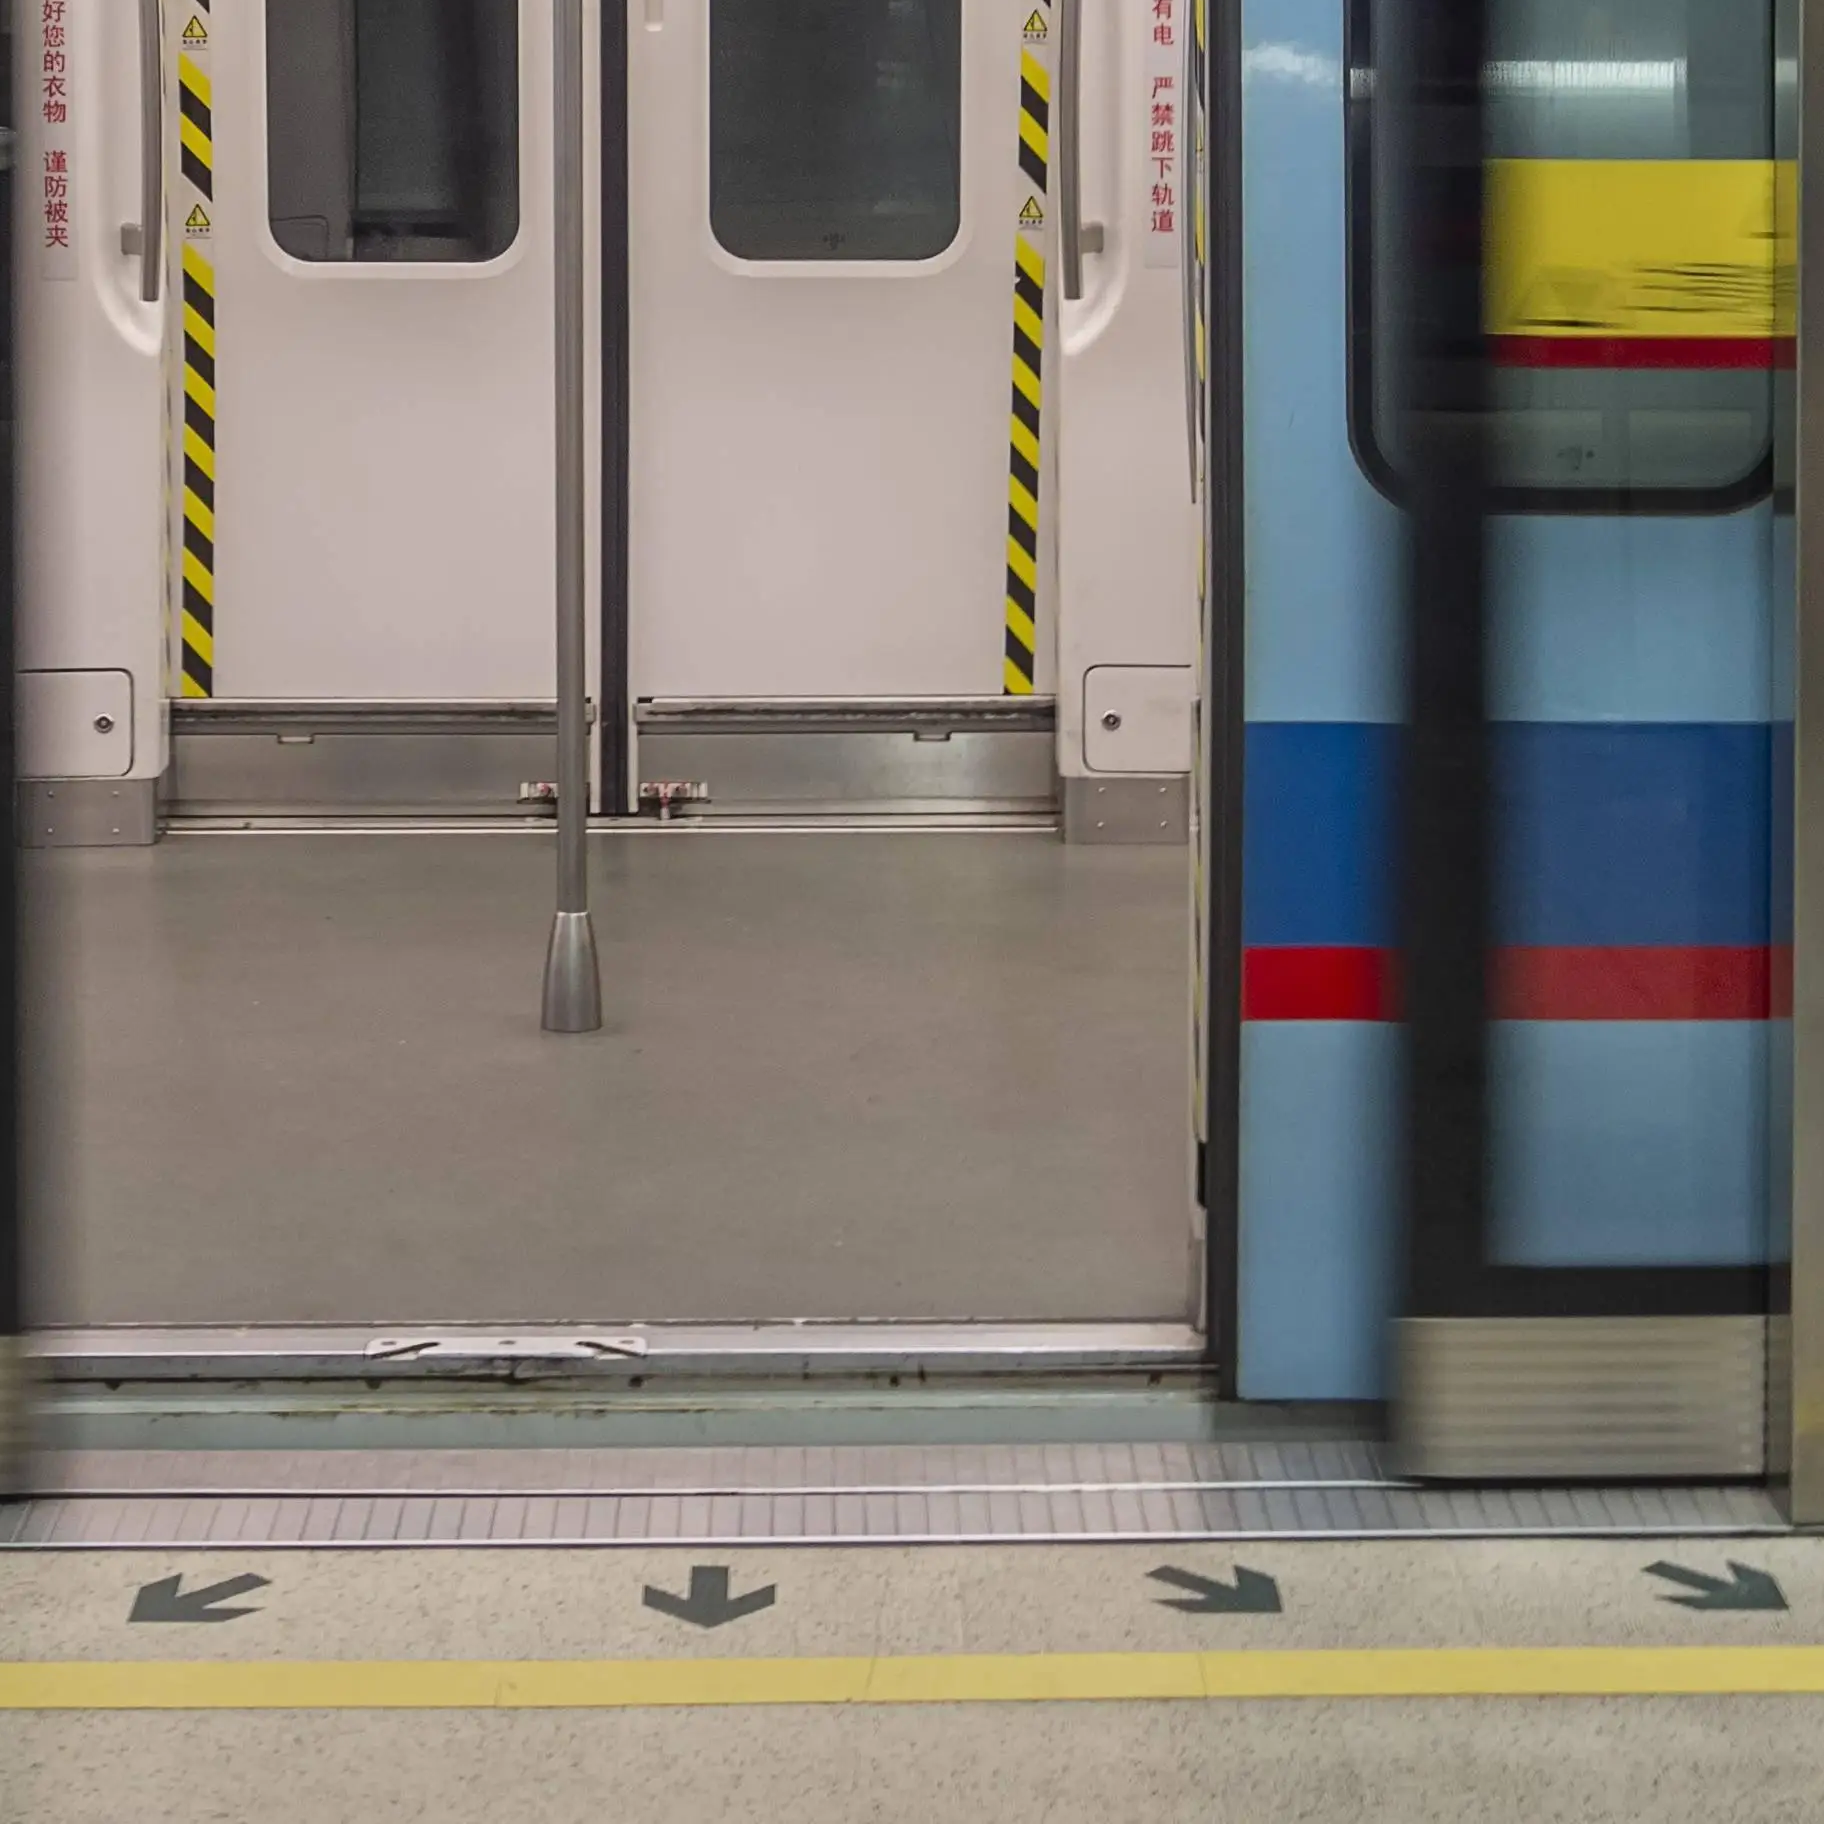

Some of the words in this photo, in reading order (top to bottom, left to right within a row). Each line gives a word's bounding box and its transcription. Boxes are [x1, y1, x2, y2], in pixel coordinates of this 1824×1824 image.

[44, 150, 69, 249] 谨防被夹
[1151, 76, 1175, 233] 严禁跳下轨道
